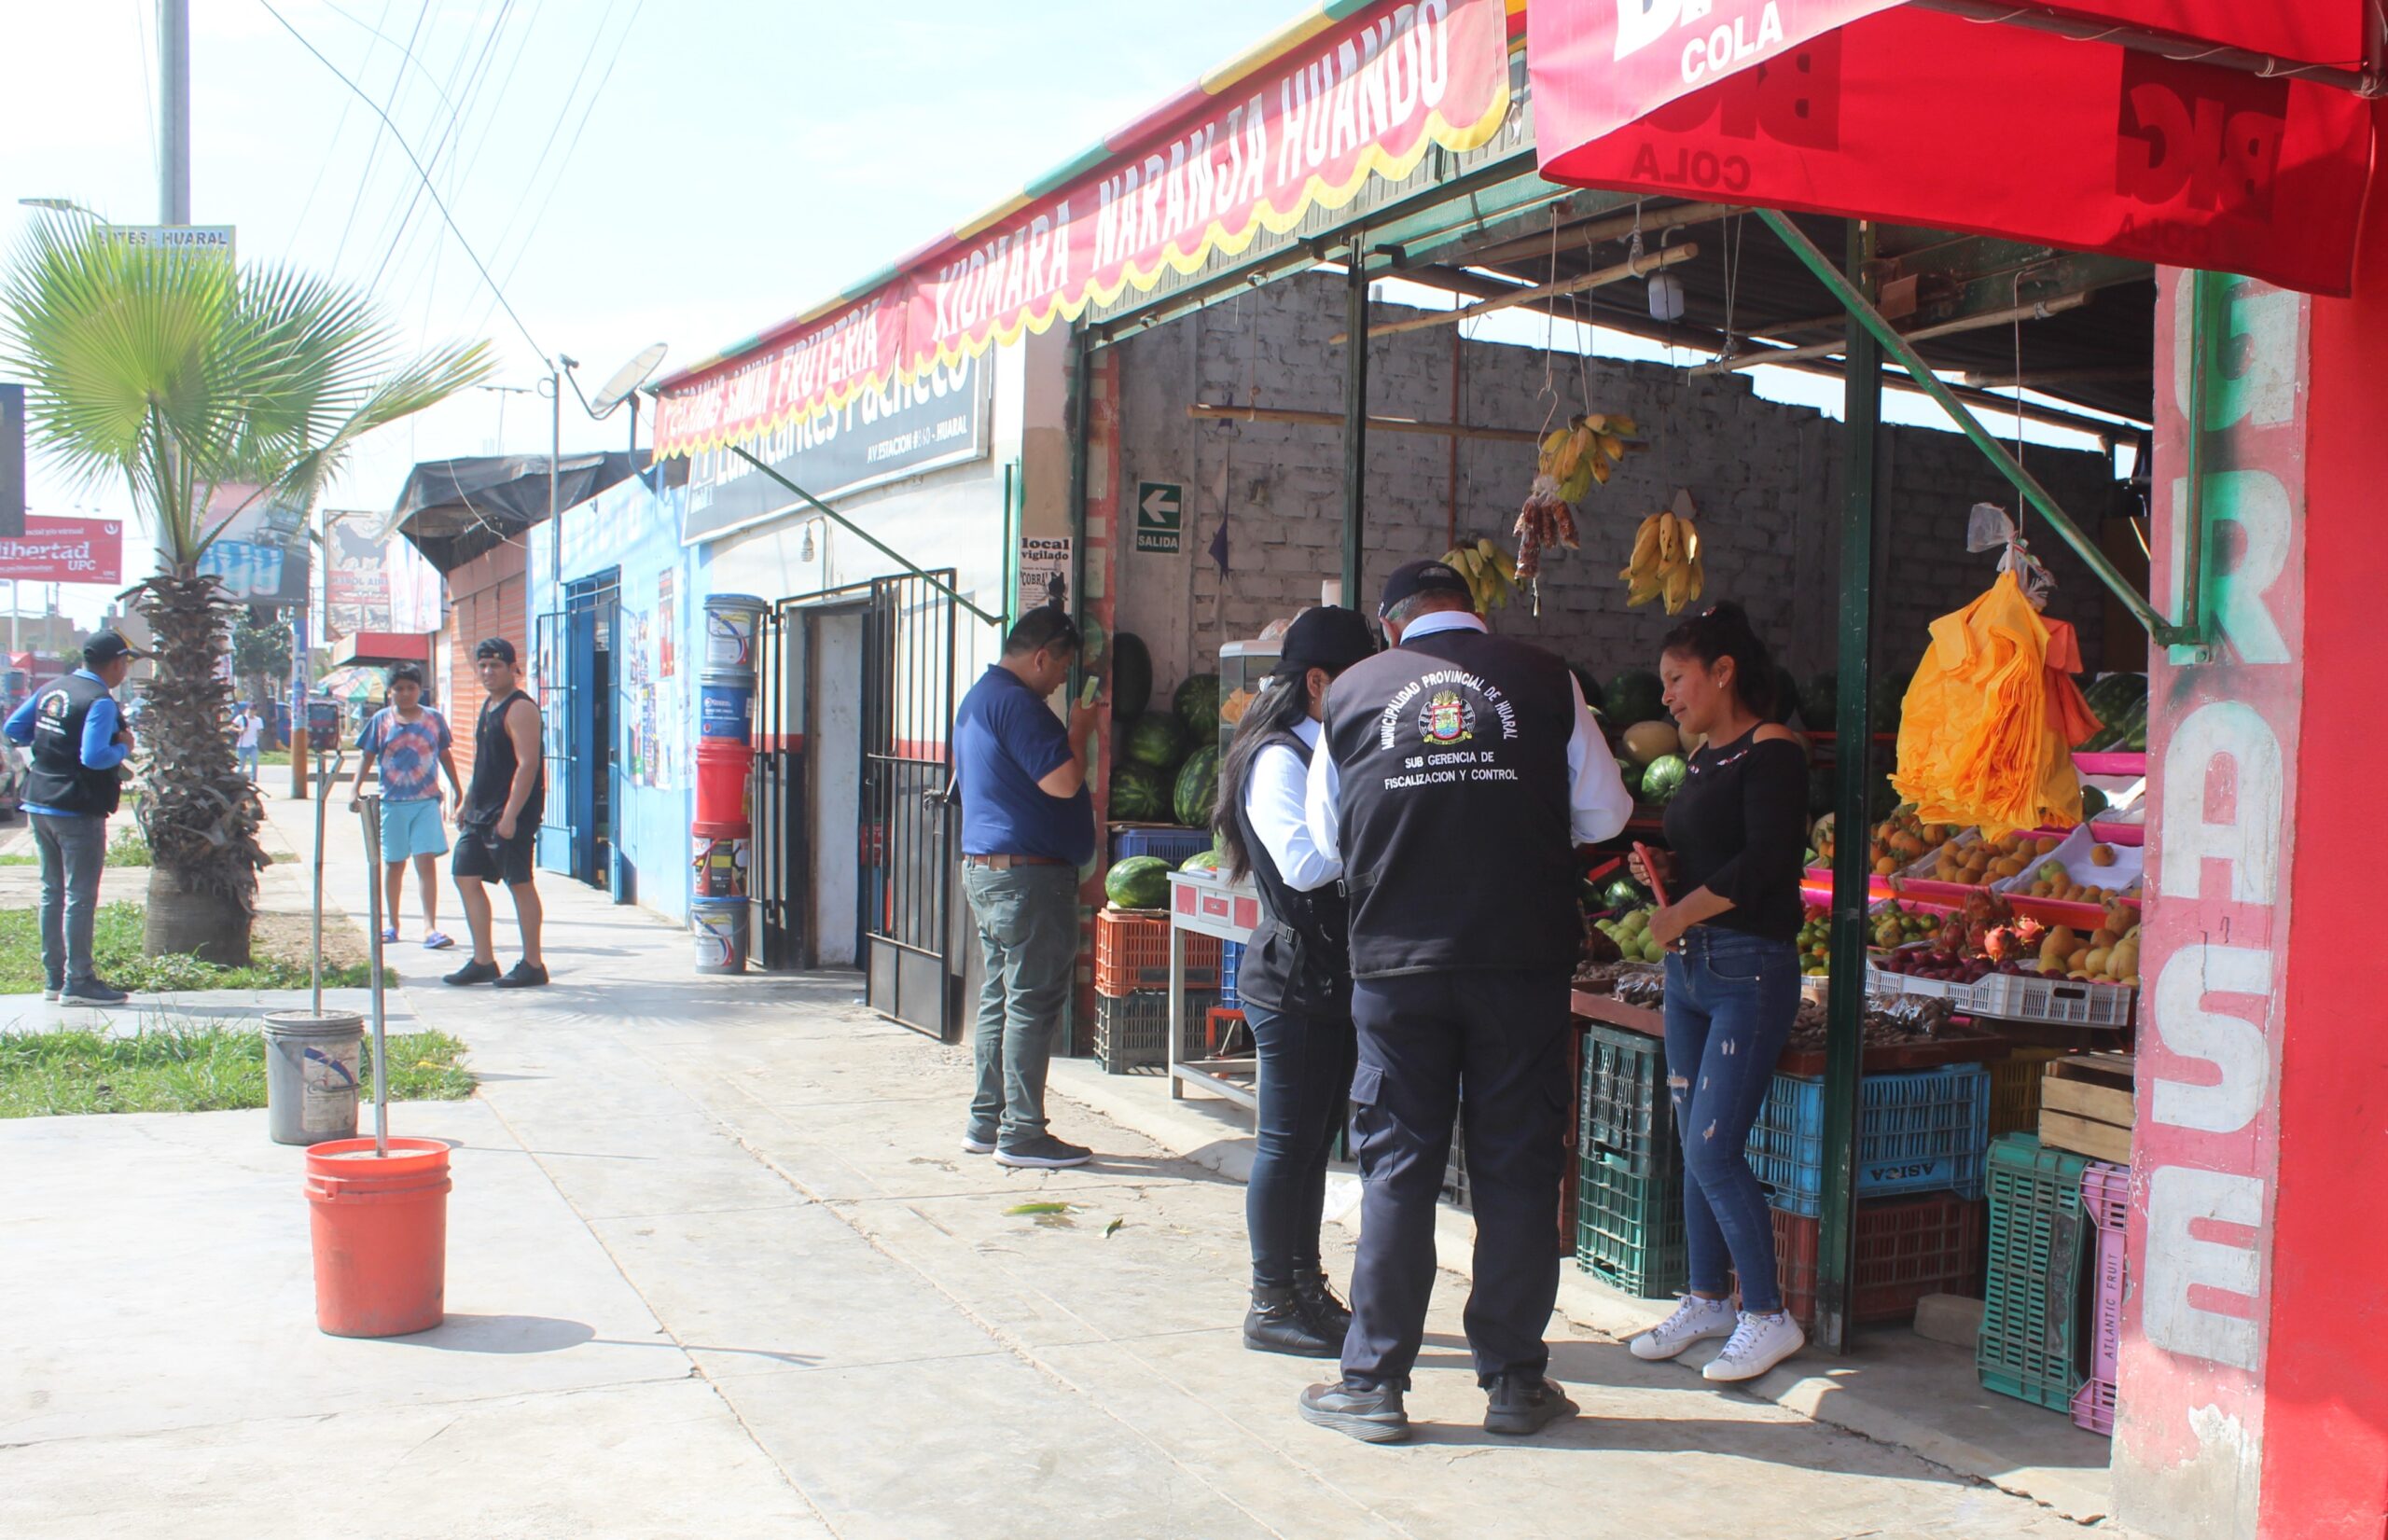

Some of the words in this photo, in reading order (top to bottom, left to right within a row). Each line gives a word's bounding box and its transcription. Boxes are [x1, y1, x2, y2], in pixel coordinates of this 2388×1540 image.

[1681, 0, 1784, 84] COLA
[773, 298, 882, 409] FRUTERIA
[933, 200, 1070, 342] XIOMARA
[1092, 92, 1268, 272] NARANJA
[1277, 0, 1449, 187] HUANDO
[161, 231, 228, 245] HUARAL
[1021, 537, 1070, 550] local
[1138, 535, 1178, 548] SALIDA
[1021, 550, 1069, 561] vigilado
[68, 560, 96, 571] UPC
[1381, 681, 1421, 750] MUNICIPALIDAD
[1422, 670, 1485, 692] PROVINCIAL
[1484, 686, 1501, 701] DE
[1494, 701, 1518, 740] HUARAL
[1405, 756, 1423, 769] SUB
[1427, 752, 1477, 766] GERENCIA
[1481, 751, 1494, 762] DE
[1384, 770, 1455, 790] FISCALIZACION
[1460, 770, 1467, 781] Y
[1471, 769, 1518, 781] CONTROL
[2105, 1253, 2117, 1290] FRUIT
[2104, 1298, 2117, 1360] ATLANTIC
